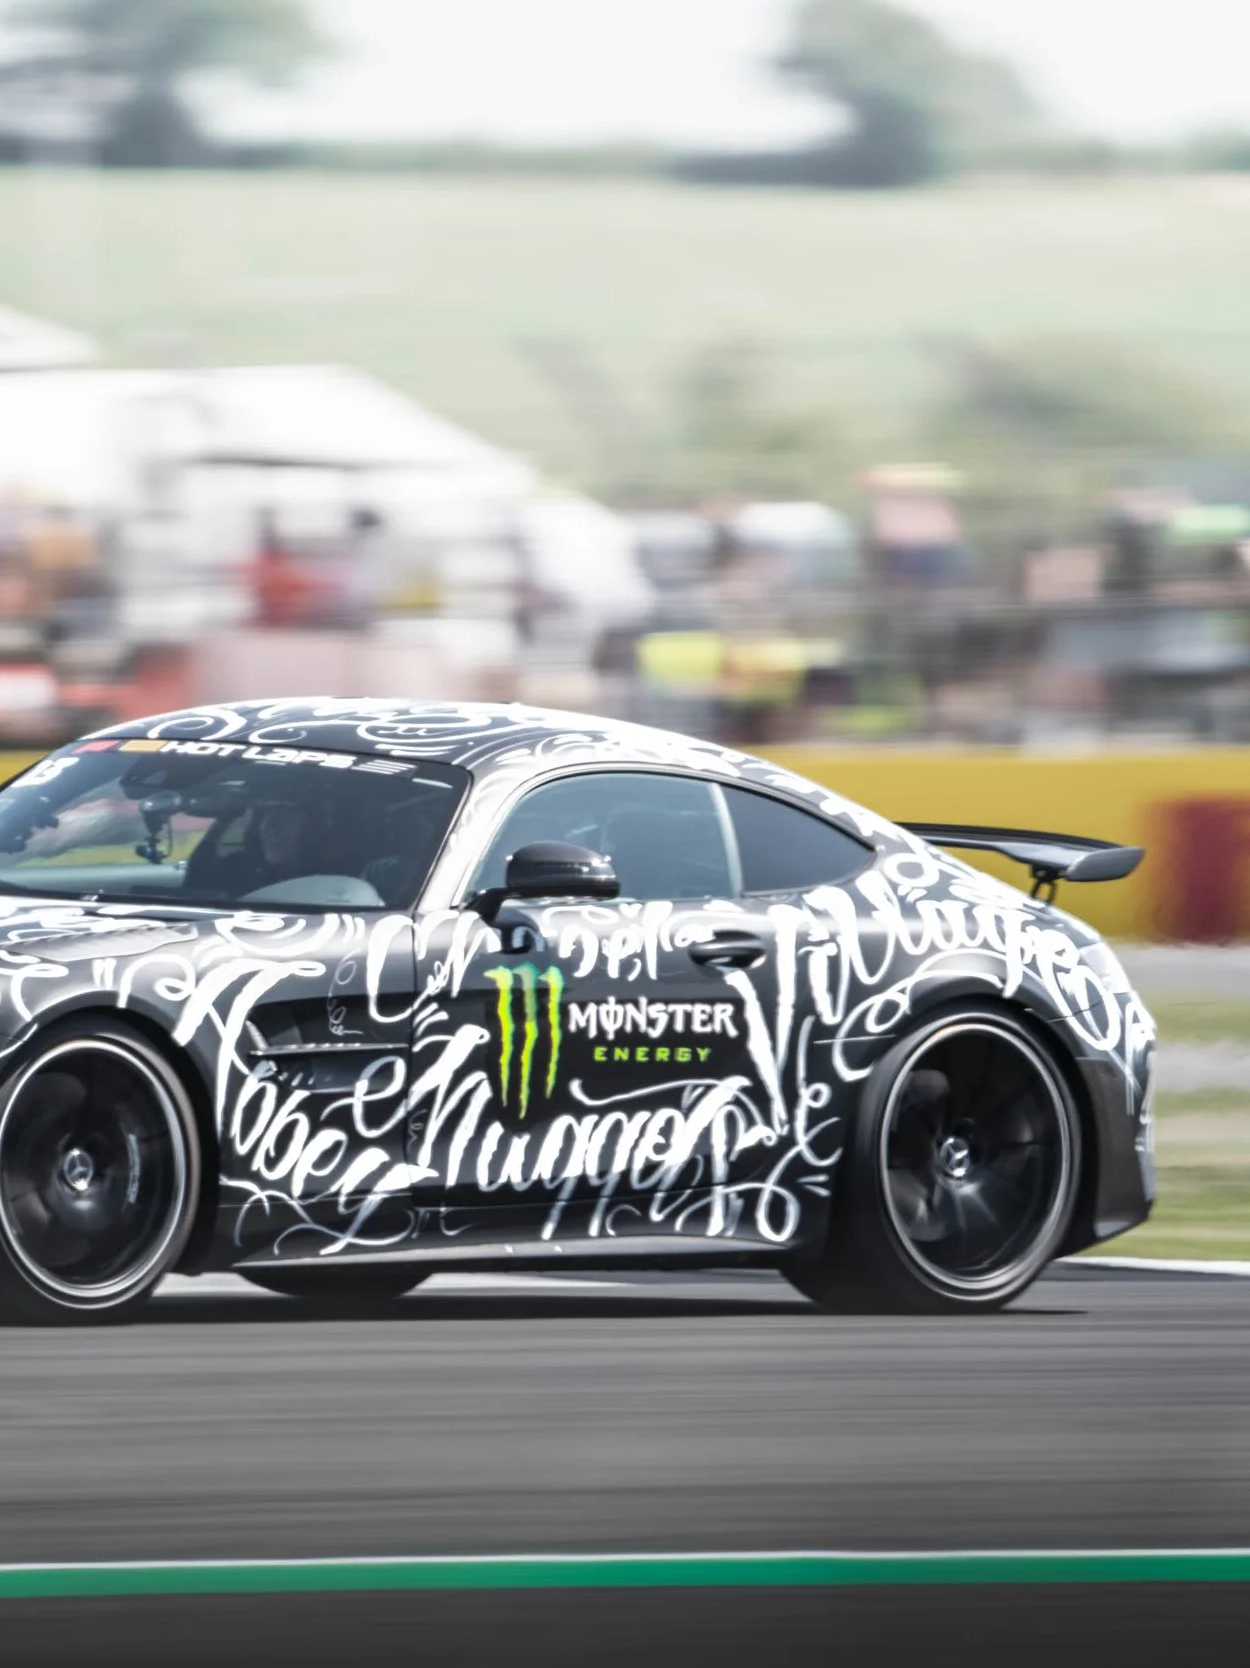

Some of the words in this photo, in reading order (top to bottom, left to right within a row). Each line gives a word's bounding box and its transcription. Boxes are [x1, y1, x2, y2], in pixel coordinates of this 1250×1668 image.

[159, 740, 246, 758] HOT
[568, 996, 739, 1041] MONSTER
[593, 1046, 712, 1063] ENERGY
